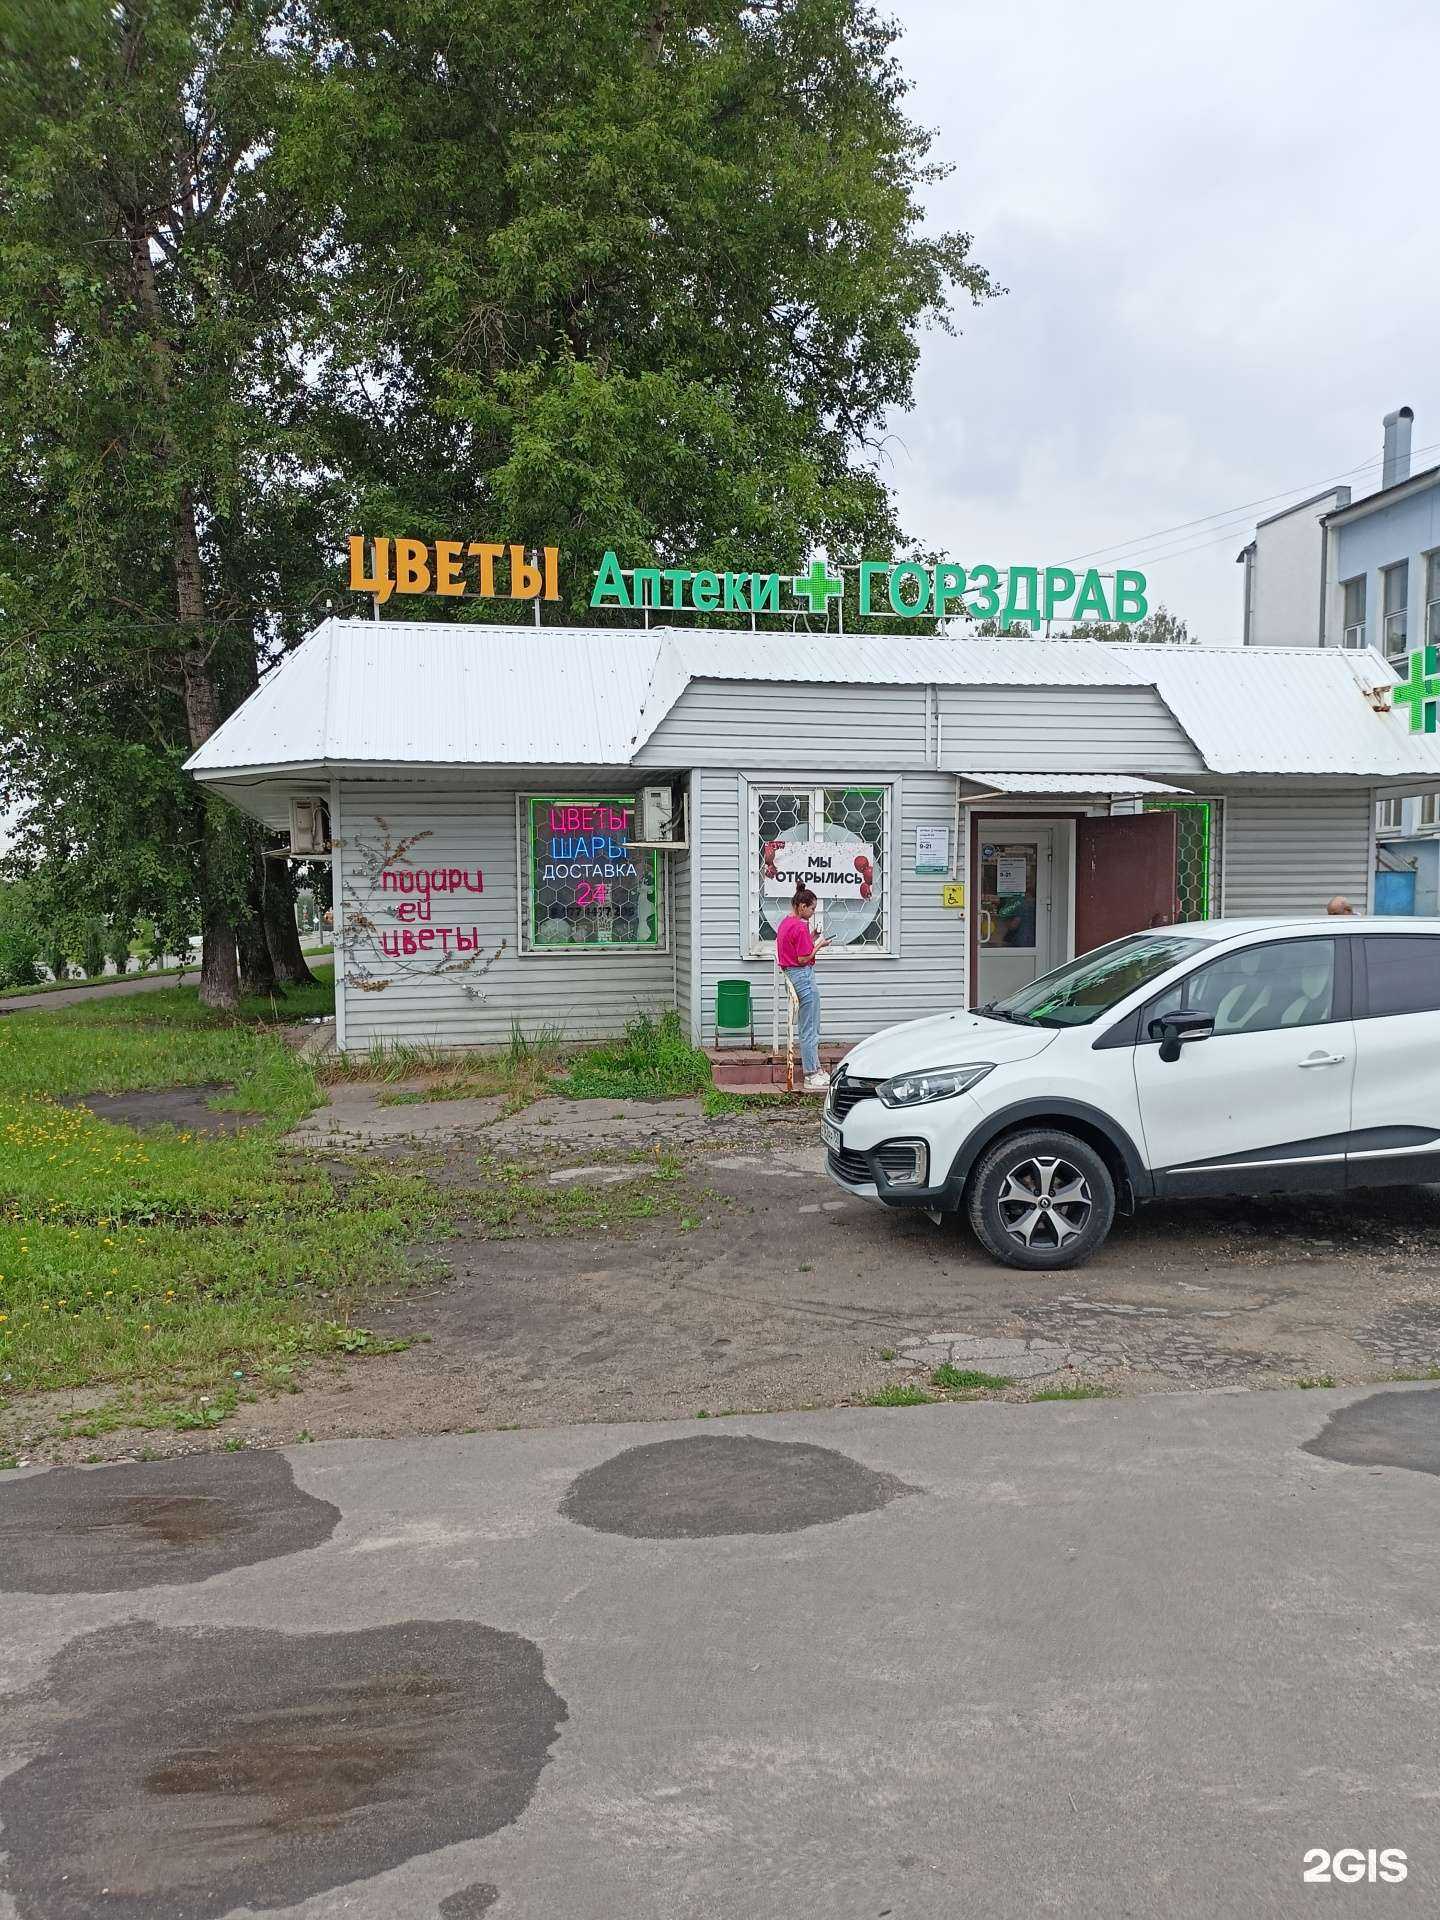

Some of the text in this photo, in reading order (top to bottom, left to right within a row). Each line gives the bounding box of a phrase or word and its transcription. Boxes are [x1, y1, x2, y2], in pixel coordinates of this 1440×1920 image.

[348, 535, 560, 604] ЦВЕТЫ
[590, 551, 1149, 631] Аптеки ГОРЗДРАВ
[550, 807, 627, 833] ЦВЕТЫ
[552, 837, 627, 859] ШАРЫ
[542, 863, 637, 880] ДОСТАВКА
[807, 856, 832, 868] МЫ
[775, 871, 863, 885] ОТКРЫЛИСЬ
[576, 881, 607, 905] 24
[382, 926, 478, 957] цветы
